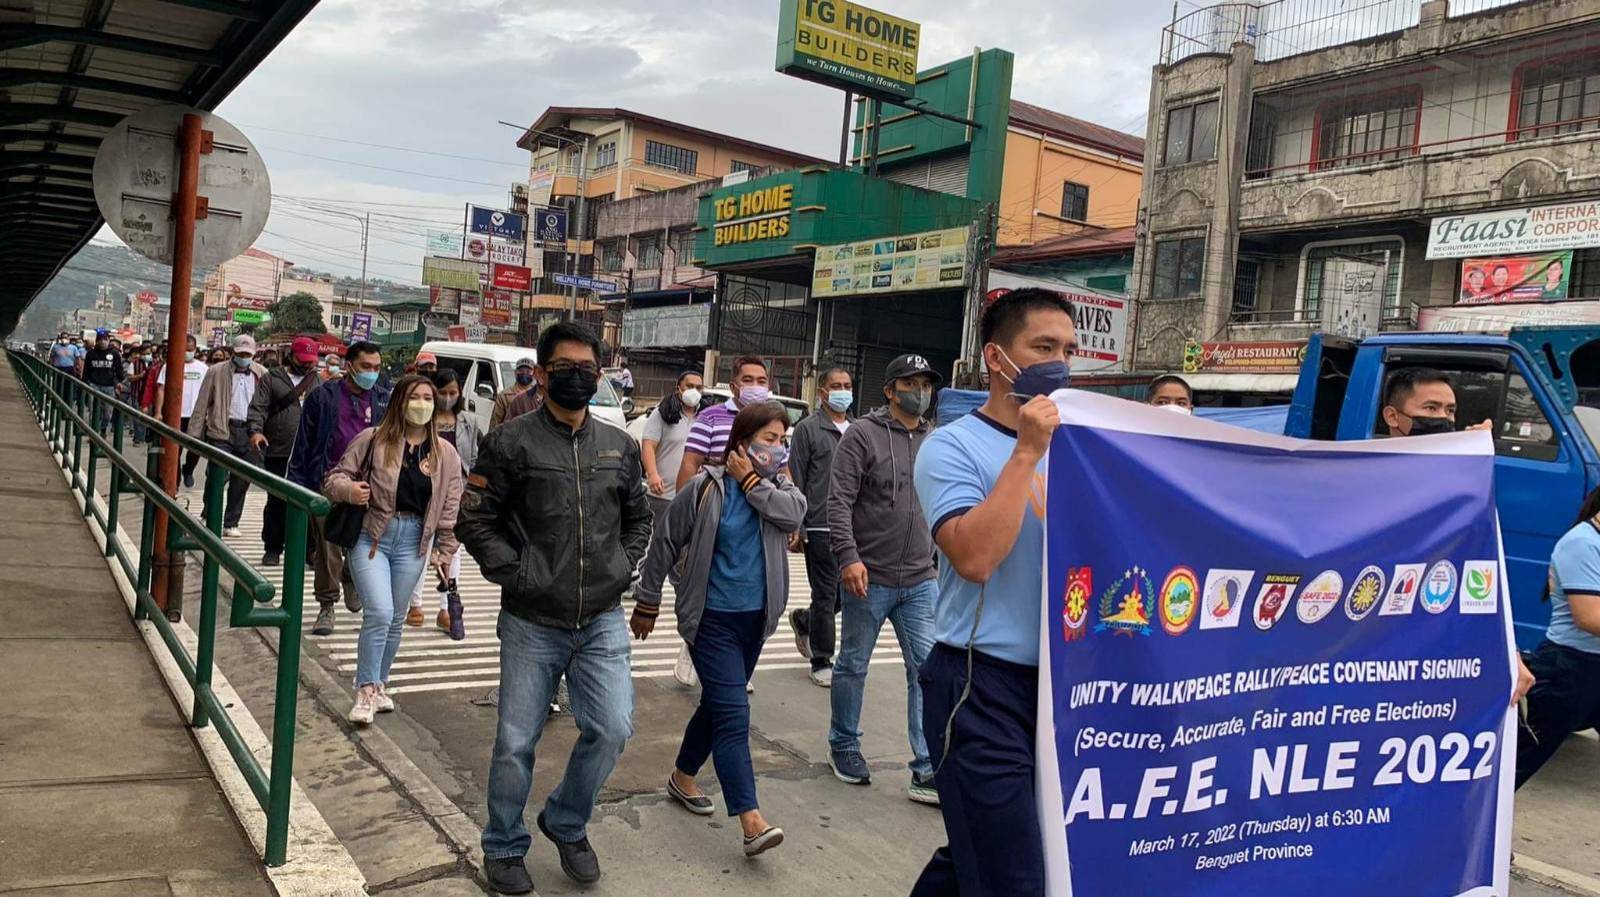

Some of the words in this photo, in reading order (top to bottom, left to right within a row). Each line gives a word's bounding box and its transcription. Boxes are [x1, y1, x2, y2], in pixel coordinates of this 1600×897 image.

[804, 0, 835, 25] TG
[845, 9, 917, 50] HOME
[798, 29, 915, 77] BUILDERS
[806, 57, 818, 67] we
[819, 59, 837, 74] Turn
[839, 66, 866, 83] Houses
[867, 75, 875, 84] to
[740, 184, 793, 216] HOME
[478, 223, 516, 235] VITORY
[714, 217, 790, 247] BUILDERS
[1436, 208, 1532, 245] Faasi
[1064, 293, 1109, 306] THENTIC
[1074, 306, 1113, 333] AVES
[1237, 347, 1299, 358] RESTAURANT
[1265, 575, 1300, 583] BENGUET
[1071, 680, 1126, 709] UNITY
[1131, 673, 1231, 706] WALK/PEACE
[1235, 662, 1329, 693] RALLY/PEACE
[1334, 659, 1418, 683] COVENANT
[1422, 658, 1481, 680] SIGNING
[1074, 727, 1166, 756] (Secure,
[1171, 716, 1246, 747] Accurate,
[1251, 710, 1287, 731] Fair
[1291, 706, 1327, 727] and
[1331, 703, 1371, 725] Free
[1375, 698, 1457, 723] Elections)
[1065, 756, 1227, 824] A.F.E.
[1249, 741, 1360, 799] NLE
[1374, 730, 1498, 786] 2022
[1129, 835, 1174, 856] March
[1180, 832, 1200, 851] 17,
[1205, 824, 1235, 845] 2022
[1239, 815, 1311, 841] (Thursday)
[1315, 813, 1328, 827] at
[1333, 810, 1363, 826] 6:30
[1366, 808, 1390, 823] AM
[1196, 848, 1249, 870] Benguet
[1253, 843, 1312, 864] Province
